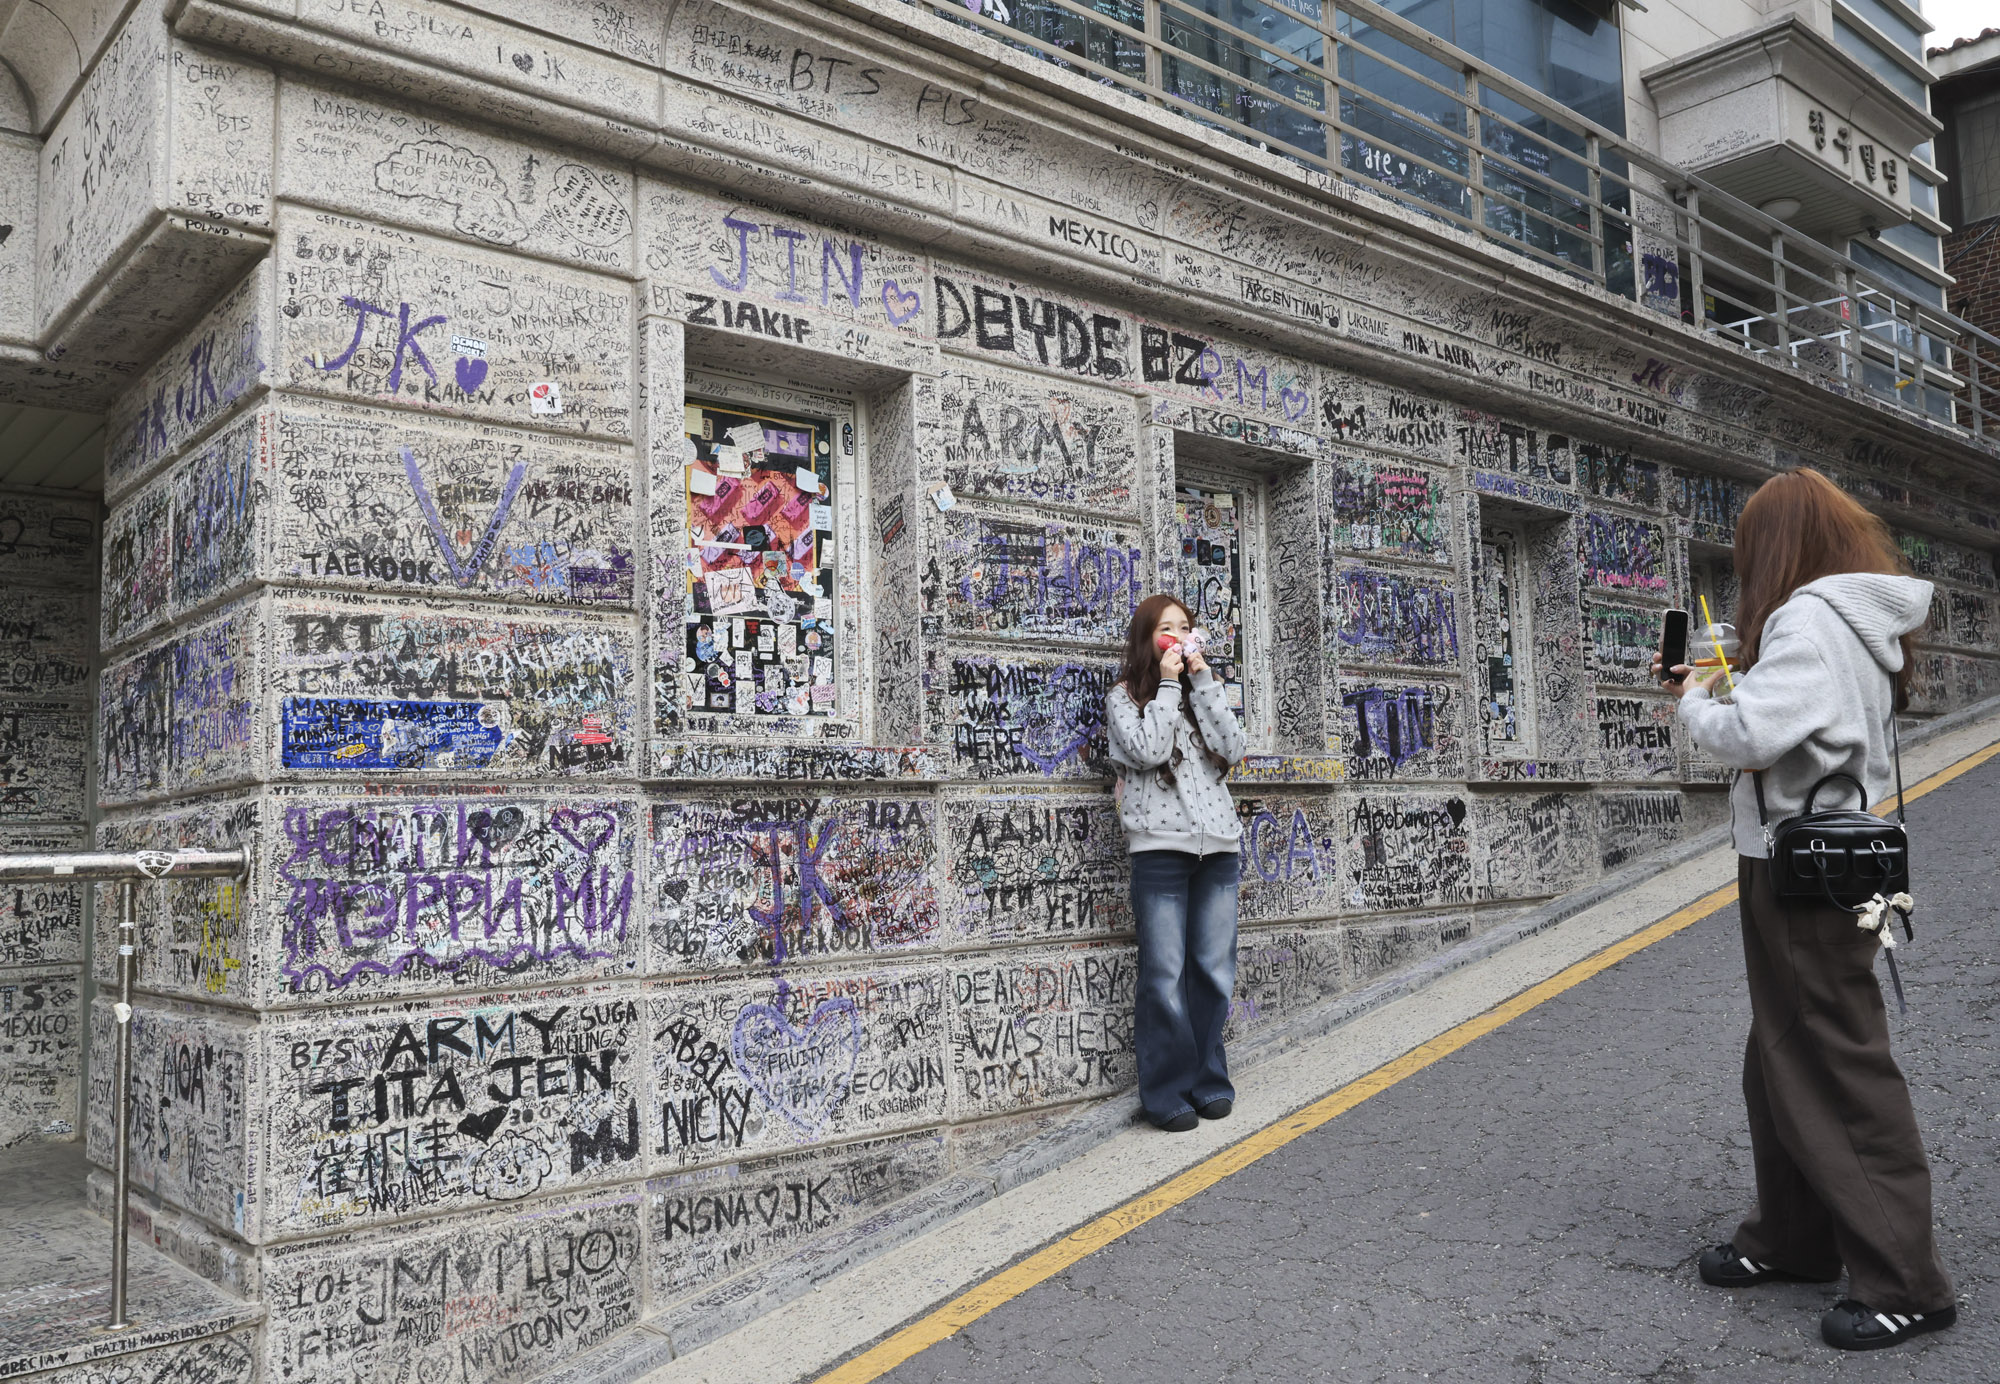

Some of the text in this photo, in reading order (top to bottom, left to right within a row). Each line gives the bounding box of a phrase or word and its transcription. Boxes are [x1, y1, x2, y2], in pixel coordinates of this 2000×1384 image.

[374, 20, 415, 42] BTS
[789, 50, 885, 95] BTS
[217, 114, 251, 132] BTS
[389, 161, 425, 177] FOR
[413, 149, 488, 174] THANKS
[186, 219, 230, 235] POLAND
[1050, 216, 1139, 264] MEXICO
[710, 217, 864, 308] JIN
[1310, 246, 1373, 277] NORWAY
[1245, 280, 1323, 322] ARGENTINA
[1347, 310, 1389, 337] UKRAINE
[1403, 331, 1429, 355] MIA
[1201, 347, 1267, 411] RM
[301, 552, 438, 586] TAEKOOK
[1342, 688, 1433, 765] JIN
[1350, 757, 1398, 780] SAMPY
[956, 957, 1120, 1008] DEAR DIARY
[381, 1004, 571, 1072] ARMY
[581, 1001, 638, 1033] SUGA
[969, 1014, 1043, 1060] WAS
[487, 1050, 617, 1104] JEN
[768, 1045, 827, 1076] FRUITY
[657, 1086, 754, 1154] NICKY
[664, 1175, 832, 1241] RISNA JK
